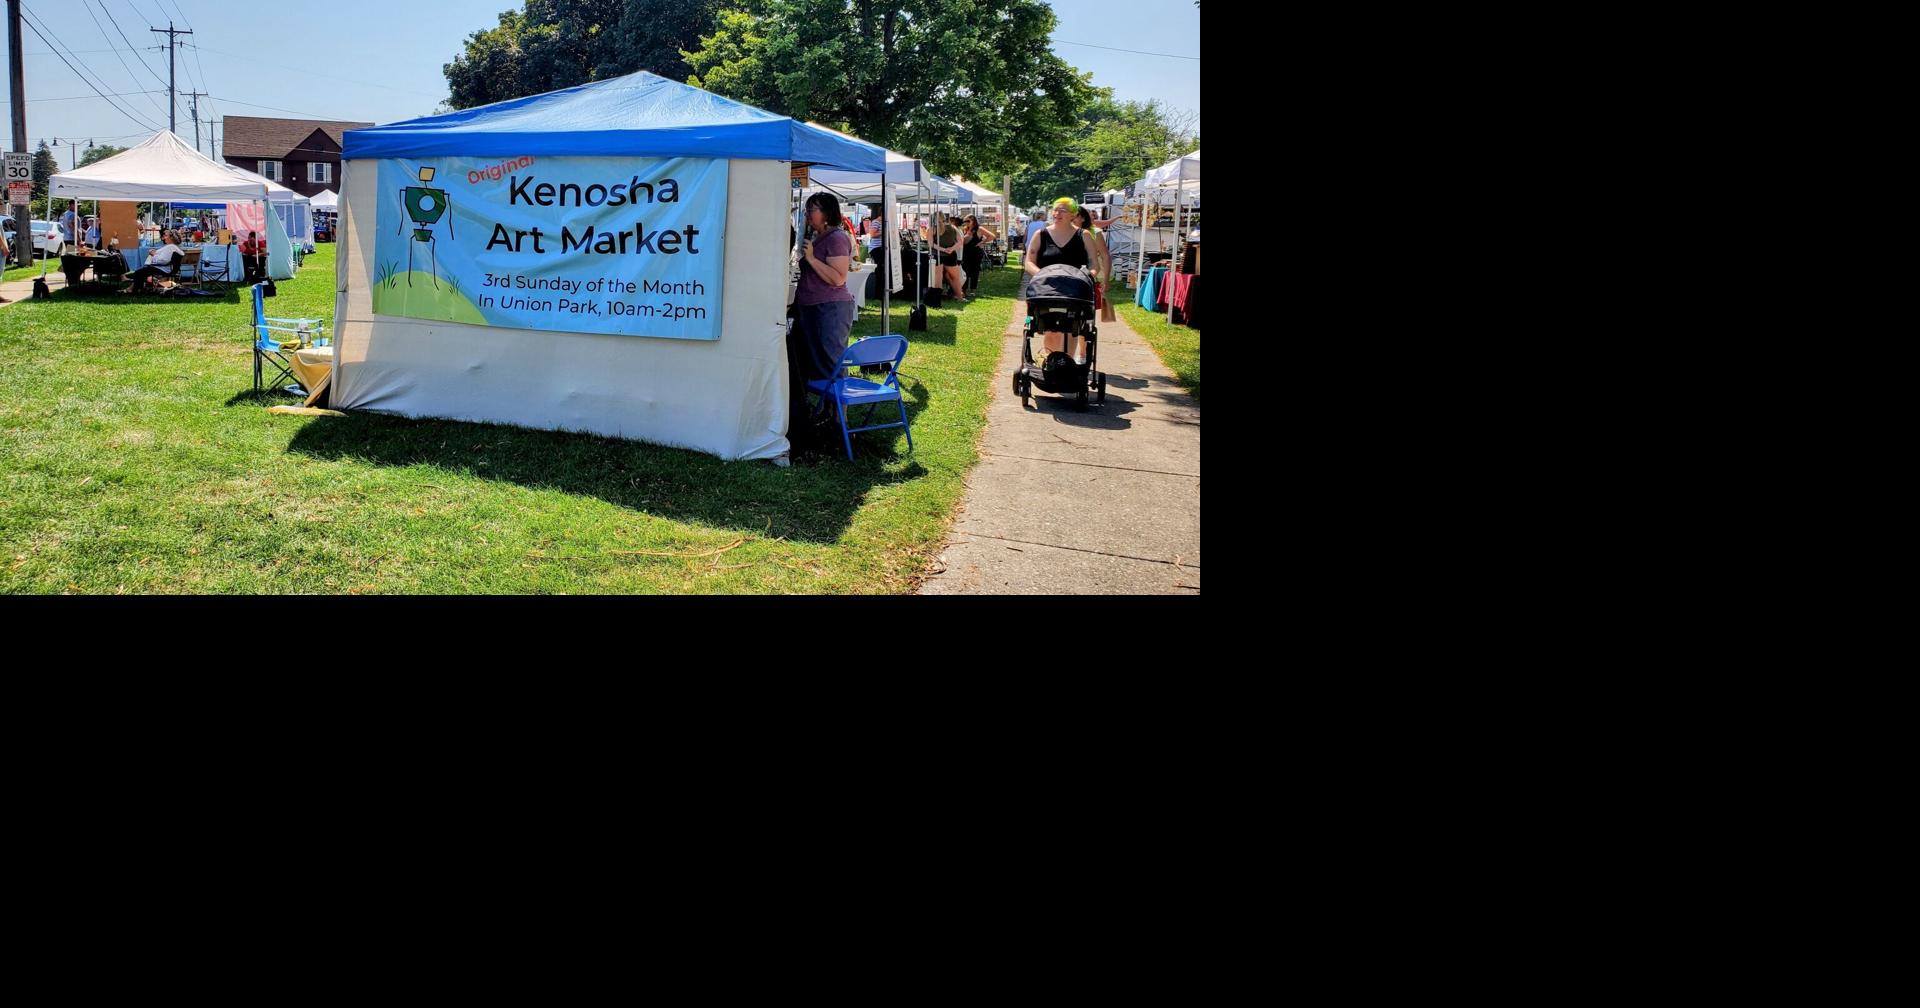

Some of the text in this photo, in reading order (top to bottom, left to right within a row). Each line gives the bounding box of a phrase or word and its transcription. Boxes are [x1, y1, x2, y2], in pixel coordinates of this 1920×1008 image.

[8, 167, 29, 178] 30
[510, 175, 679, 207] Kenosha
[486, 222, 700, 255] Art Market
[482, 273, 705, 296] 3rd Sunday of the Month
[479, 293, 706, 321] In Union Park, 10am-2pm
